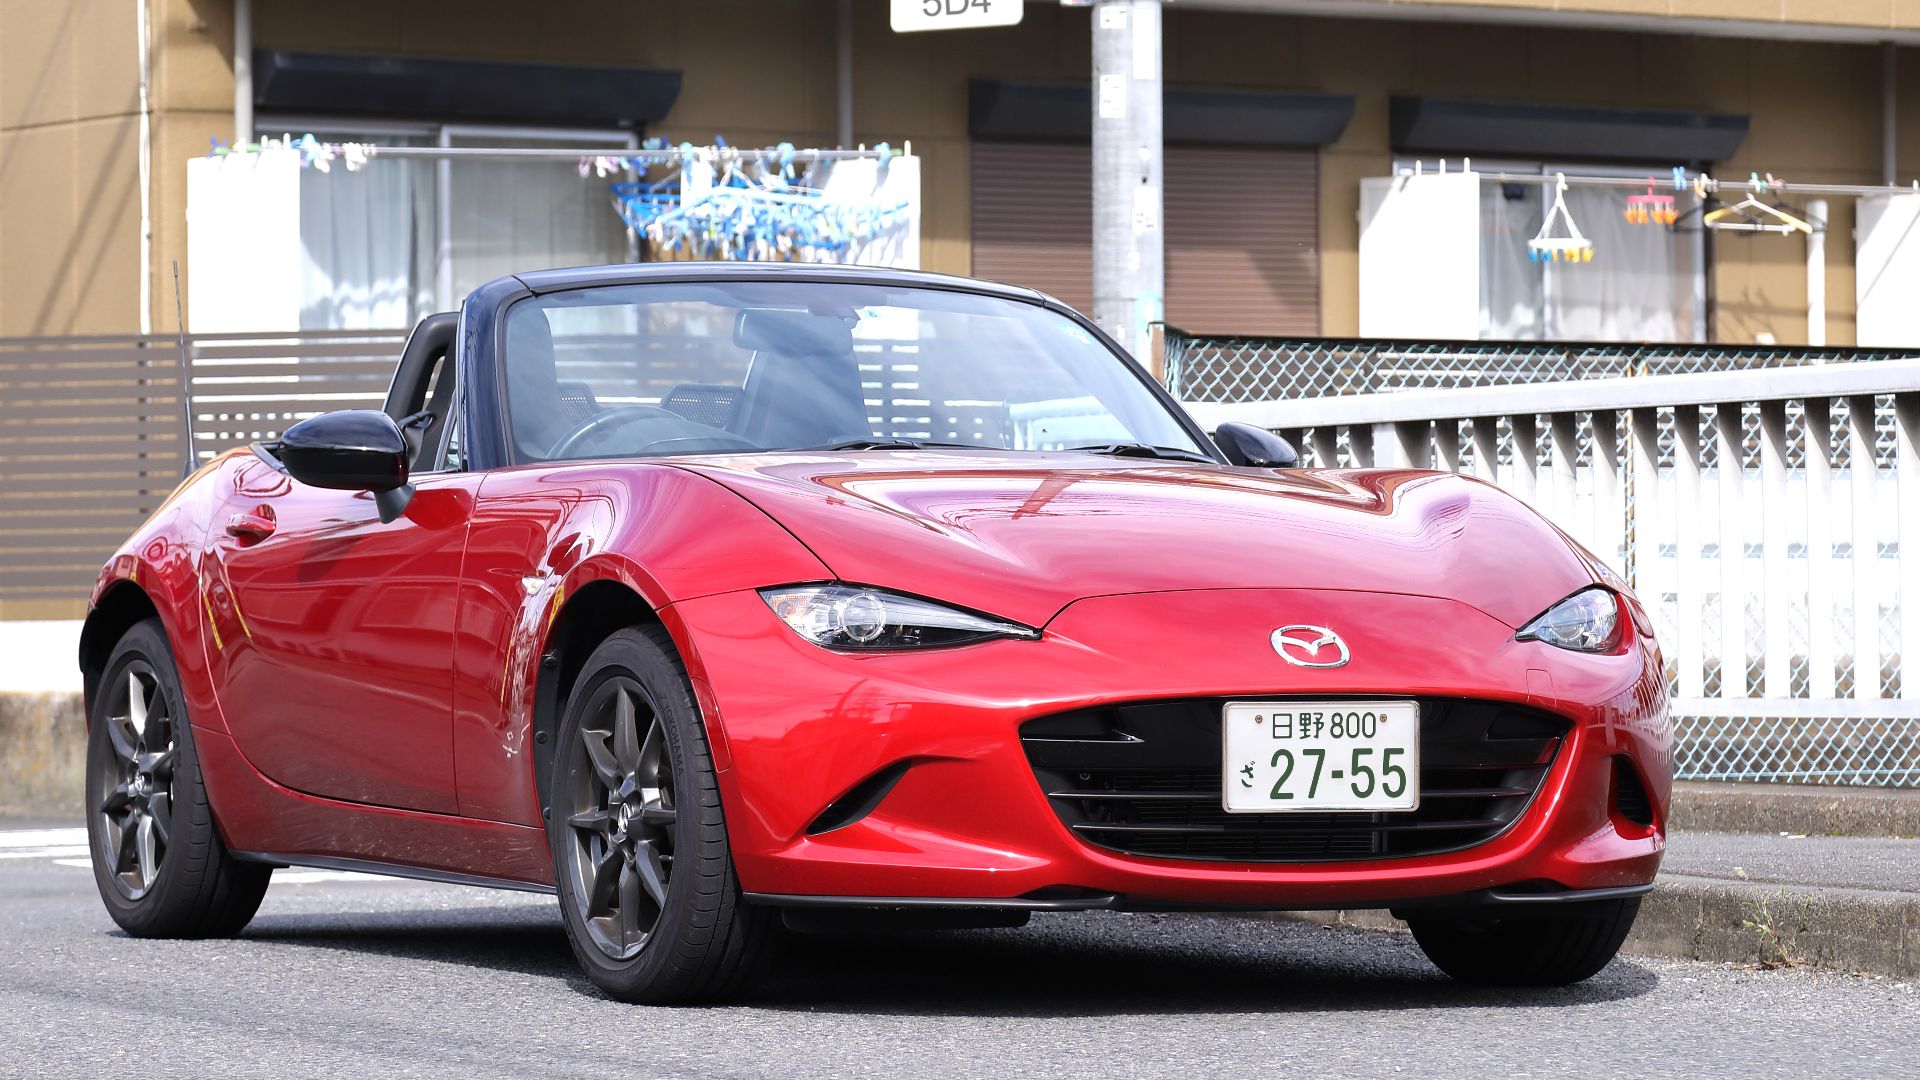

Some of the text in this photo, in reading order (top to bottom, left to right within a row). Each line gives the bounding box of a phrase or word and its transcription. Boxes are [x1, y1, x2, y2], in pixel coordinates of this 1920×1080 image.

[663, 702, 684, 776] YOKOHAMA
[1240, 748, 1407, 799] ざ 27-55
